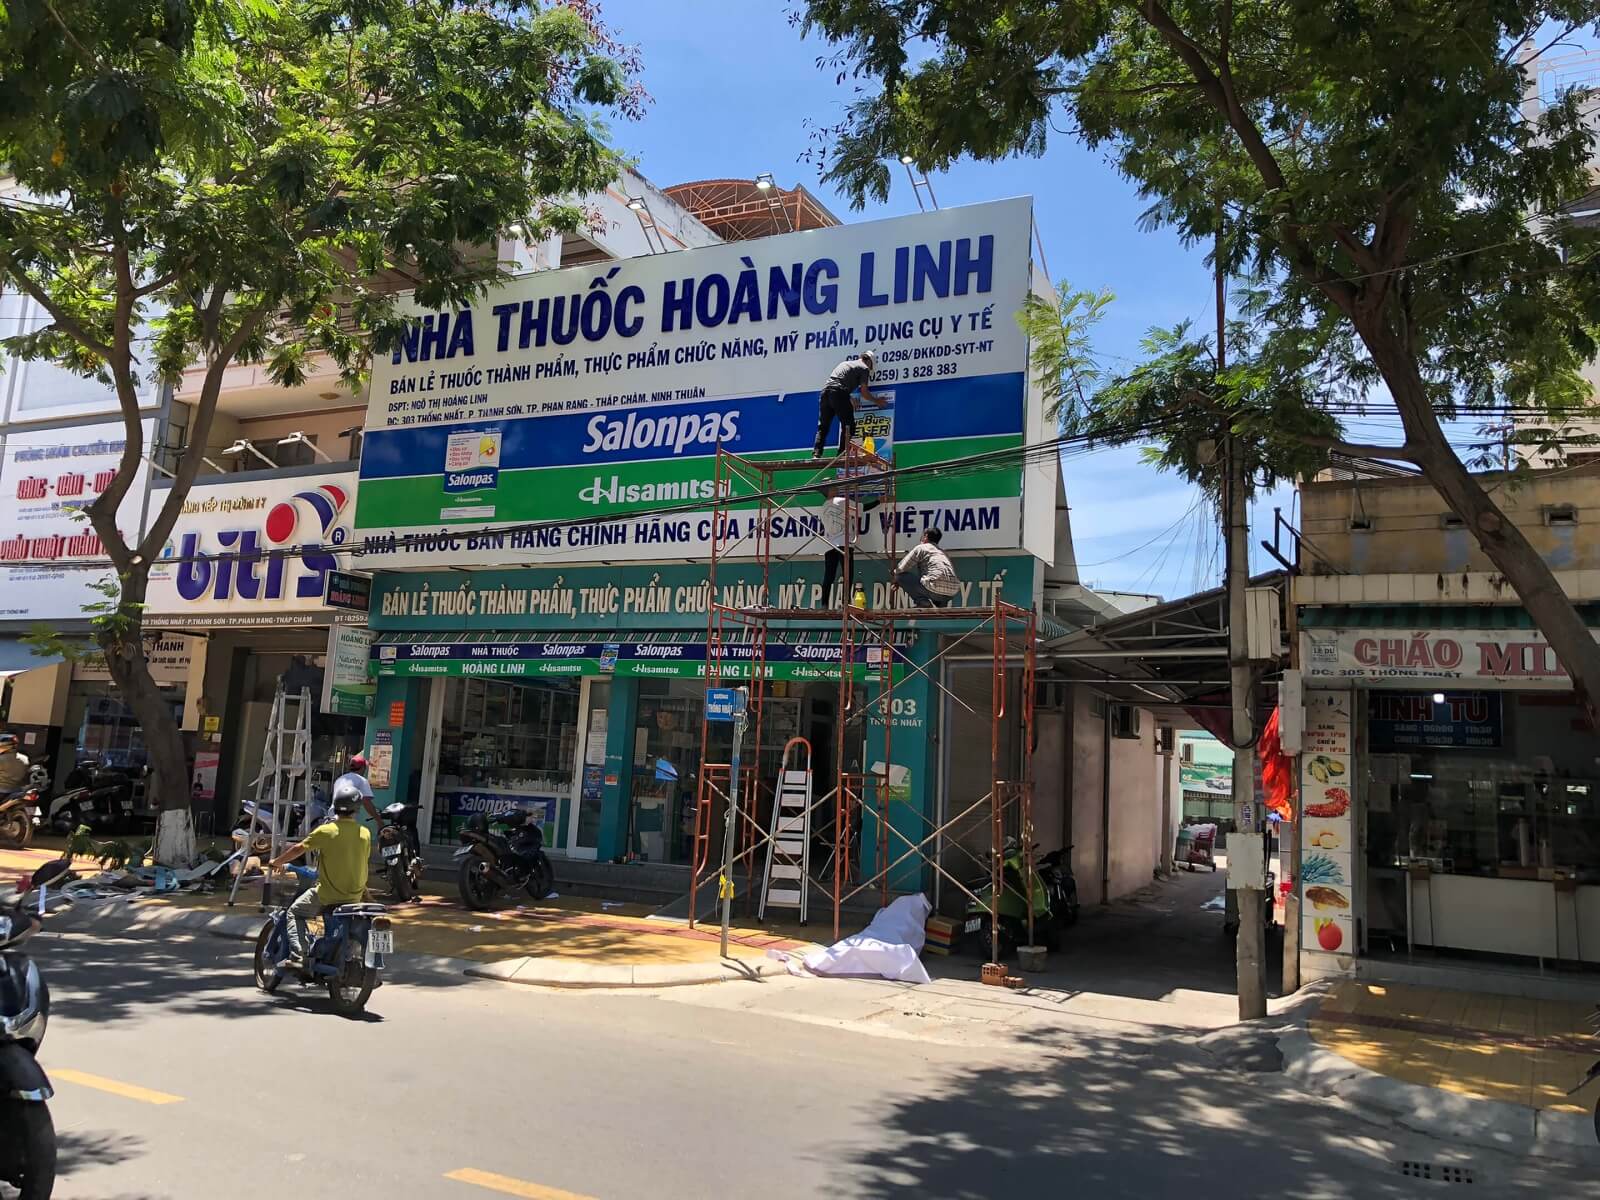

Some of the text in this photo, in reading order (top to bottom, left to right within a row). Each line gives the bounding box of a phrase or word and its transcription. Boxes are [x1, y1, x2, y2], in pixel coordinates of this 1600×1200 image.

[392, 234, 994, 365] NHÀ THUỐC HOÀNG LINH
[390, 303, 996, 395] BÁN LẺ THUỐC THÀNH PHẨM, THỰC PHẨM CHỨC NĂNG, MỸ PHẨM, DỤNG CỤ Y TẾ
[869, 362, 957, 383] 0259) 3 828 383
[470, 393, 488, 405] LINH
[478, 407, 504, 418] THANH
[541, 401, 564, 412] PHAN
[565, 399, 588, 410] RANG
[596, 395, 620, 407] THÁP
[651, 391, 673, 402] NINH
[582, 410, 740, 454] Salonpas
[448, 473, 494, 487] Salonpas
[578, 475, 732, 505] Hisamitsu
[567, 521, 627, 547] CHÍNH
[634, 518, 691, 544] HÃNG
[880, 506, 934, 538] VIỆT
[944, 506, 1000, 532] NAM
[381, 585, 410, 616] BÁN
[411, 582, 429, 616] LẺ
[431, 580, 477, 616] THUỐC
[480, 584, 527, 615] THÀNH
[529, 576, 577, 619] PHẨM,
[579, 582, 620, 618] THỰC
[623, 572, 672, 613] PHẨM
[675, 579, 718, 614] CHỨC
[778, 577, 809, 610] MỸ
[410, 645, 451, 658] Salonpas
[471, 643, 519, 656] NHÀ THUỐC
[541, 643, 587, 657] Salonpas
[634, 644, 683, 659] Salonpas
[462, 661, 526, 674] HOÀNG LINH
[631, 664, 679, 675] Hisamitsu
[744, 665, 774, 677] LNH
[878, 698, 916, 716] 303
[1369, 695, 1433, 721] INH
[458, 793, 519, 817] Salonpas
